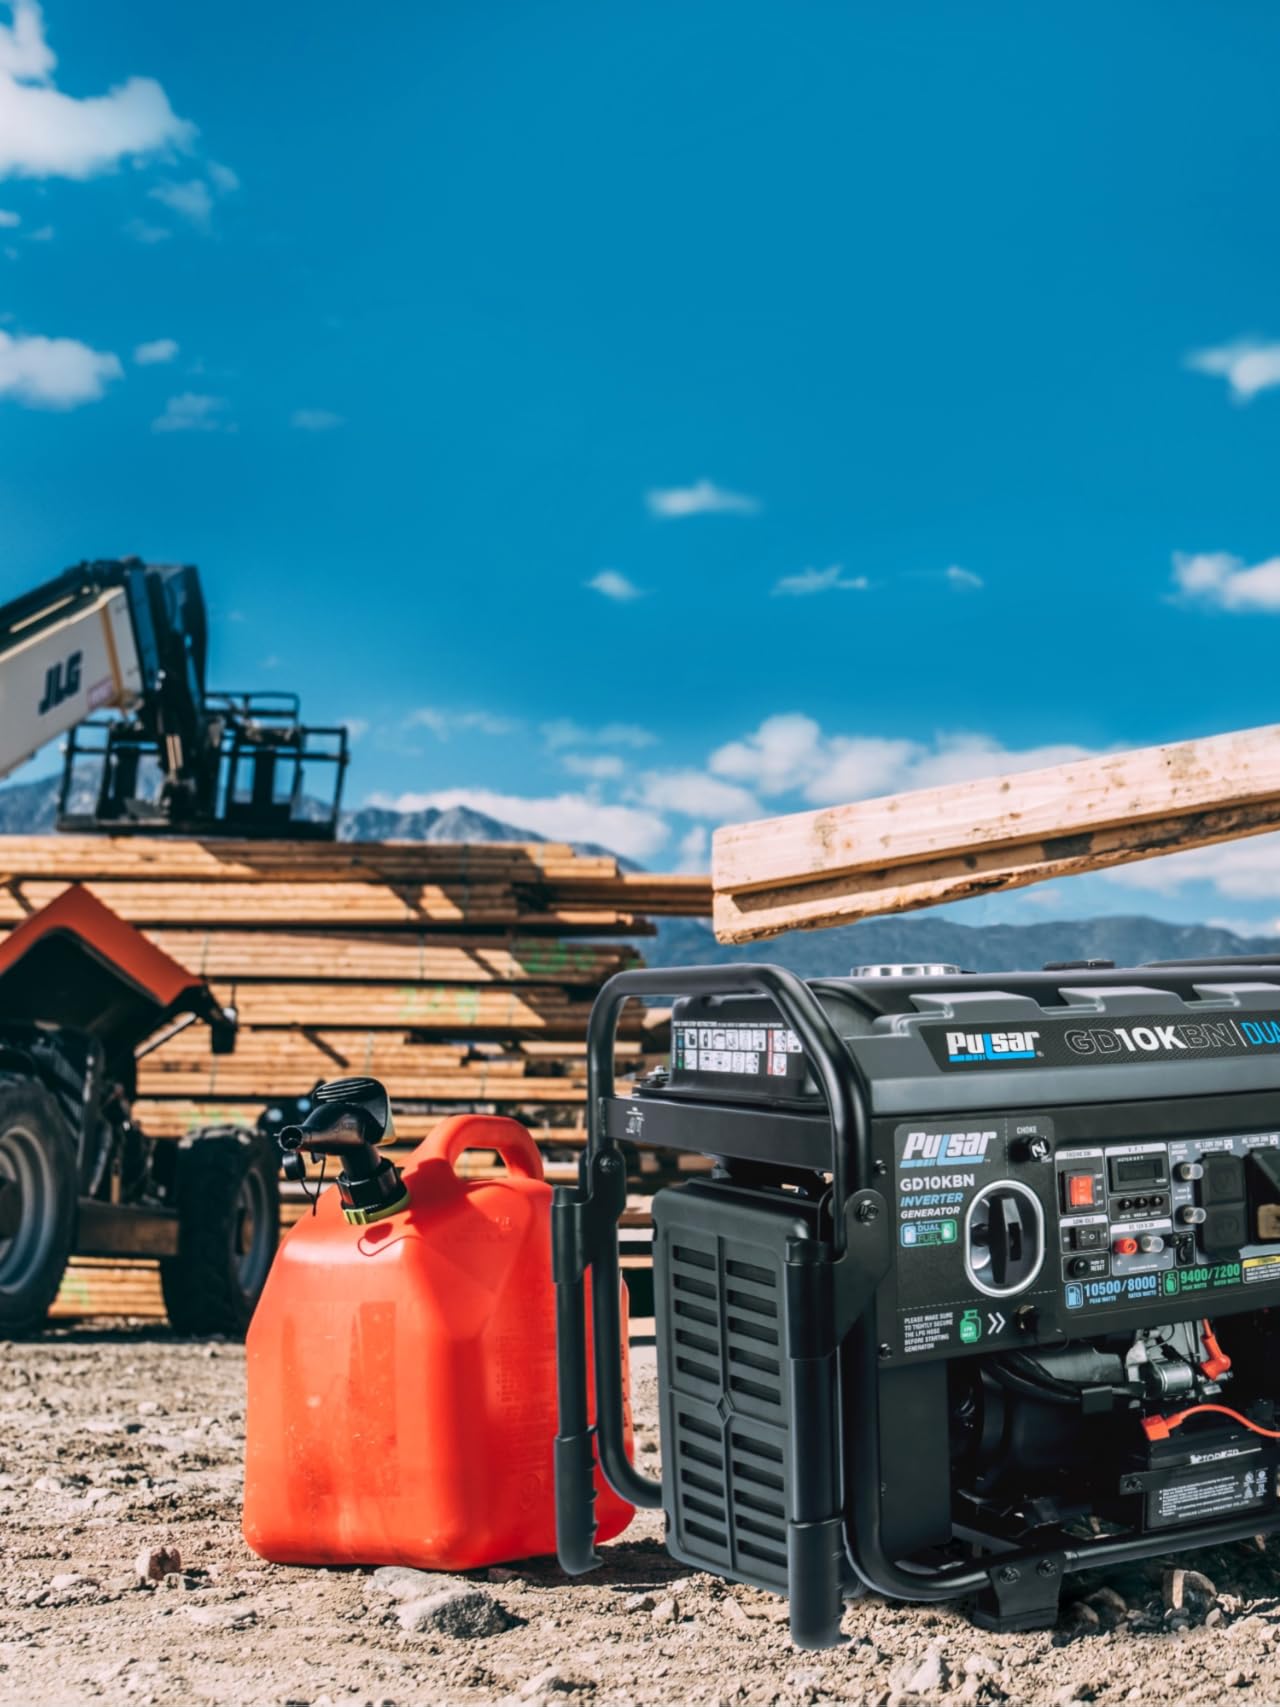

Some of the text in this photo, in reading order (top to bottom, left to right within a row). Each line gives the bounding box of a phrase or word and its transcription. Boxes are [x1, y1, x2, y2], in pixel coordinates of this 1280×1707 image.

[38, 650, 83, 716] JLG
[945, 1031, 1041, 1063] Pulsar
[1064, 1022, 1238, 1054] GD10KBN
[900, 1131, 998, 1168] Pulsar
[900, 1173, 975, 1192] GD10KBN
[900, 1192, 964, 1207] INVERTER
[900, 1205, 961, 1219] GENERATOR
[917, 1224, 940, 1232] DUAL
[1180, 1263, 1240, 1284] 9400/7200
[1084, 1275, 1157, 1297] 10500/8000
